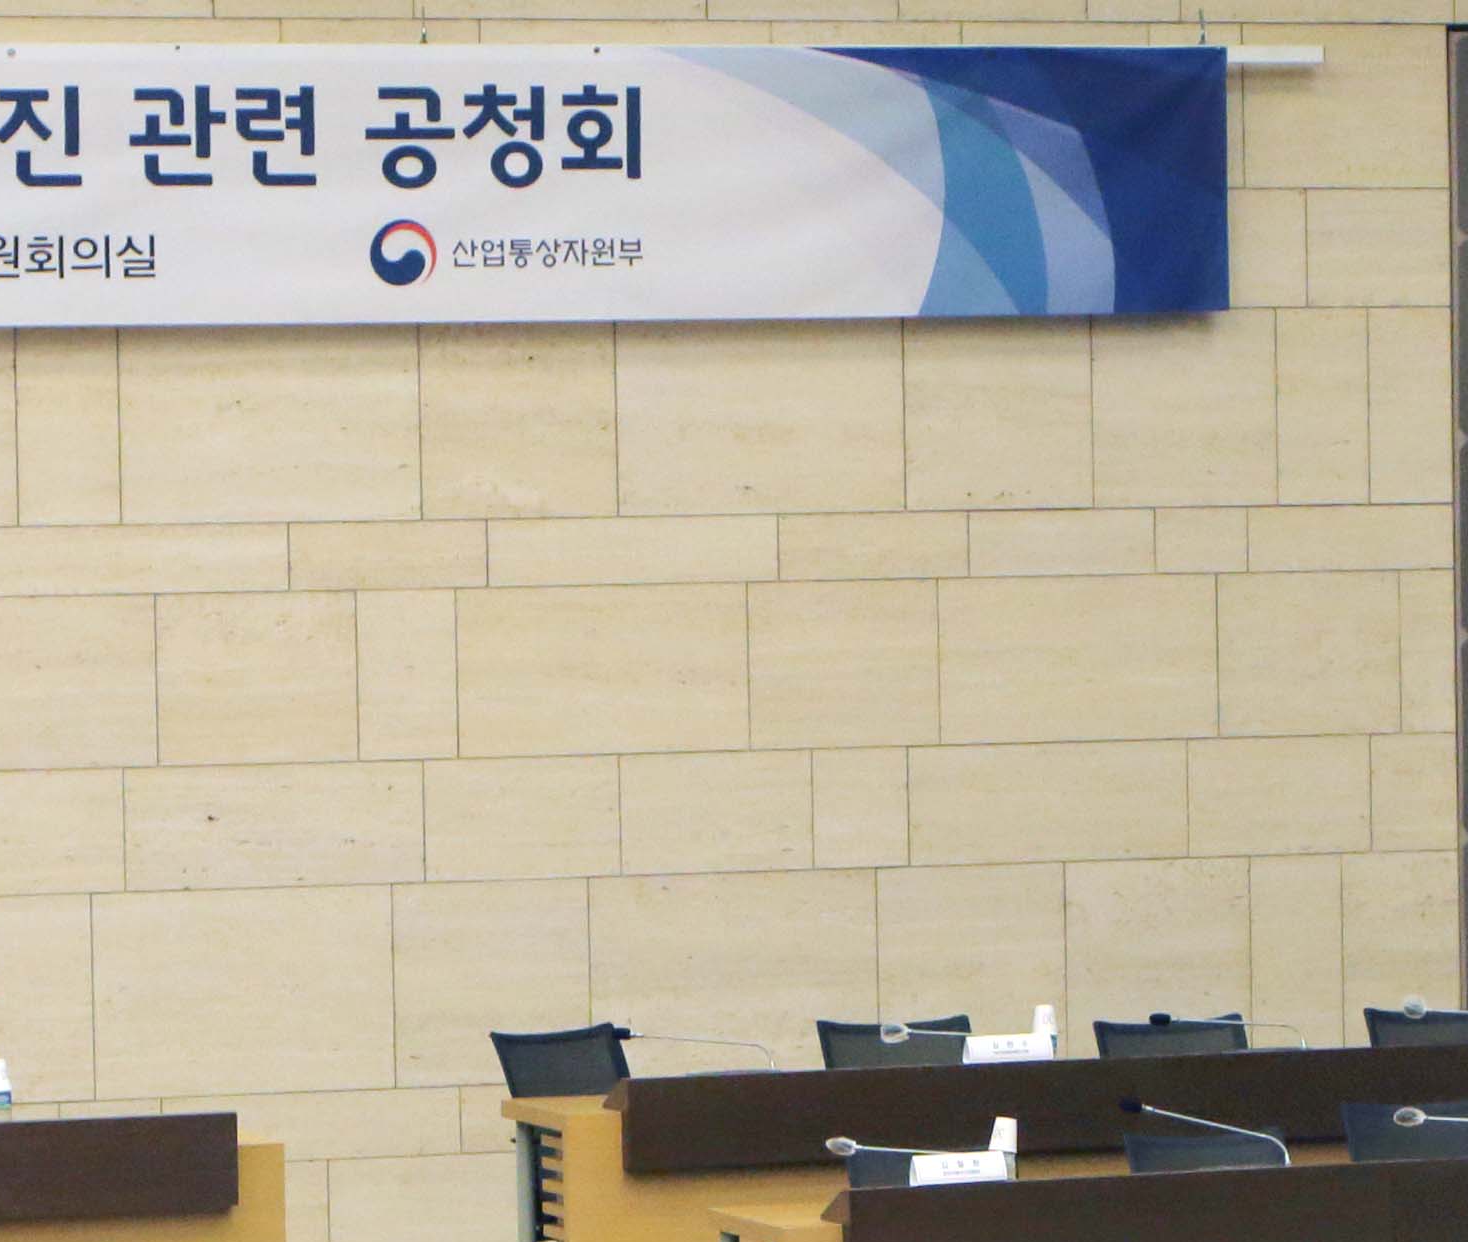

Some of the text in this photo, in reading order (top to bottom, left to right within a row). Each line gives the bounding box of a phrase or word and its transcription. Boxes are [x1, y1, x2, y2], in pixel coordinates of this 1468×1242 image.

[128, 83, 317, 187] 관련
[364, 83, 642, 189] 공청회
[452, 237, 643, 269] 산업통상자원부
